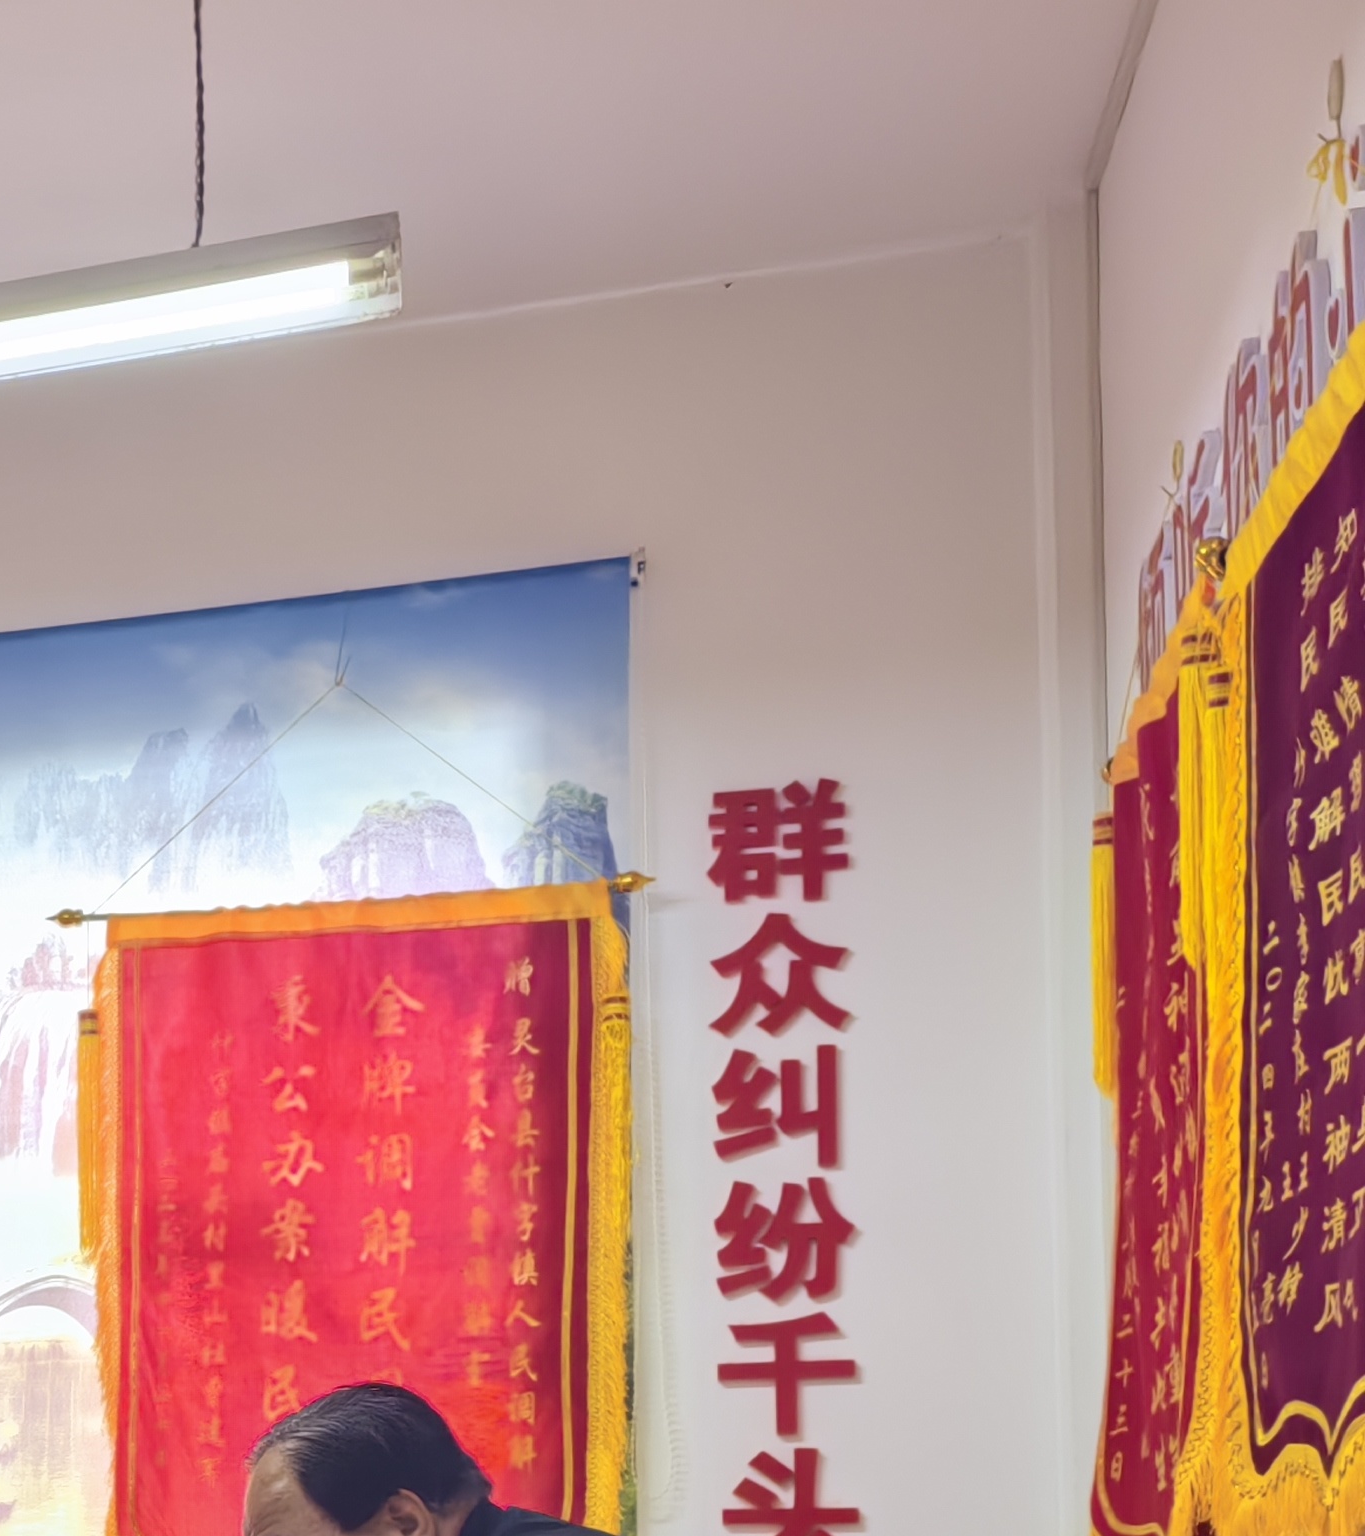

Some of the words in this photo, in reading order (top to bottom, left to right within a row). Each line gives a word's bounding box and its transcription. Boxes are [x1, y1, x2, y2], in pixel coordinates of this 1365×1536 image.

[359, 973, 426, 1382] 金牌调解民
